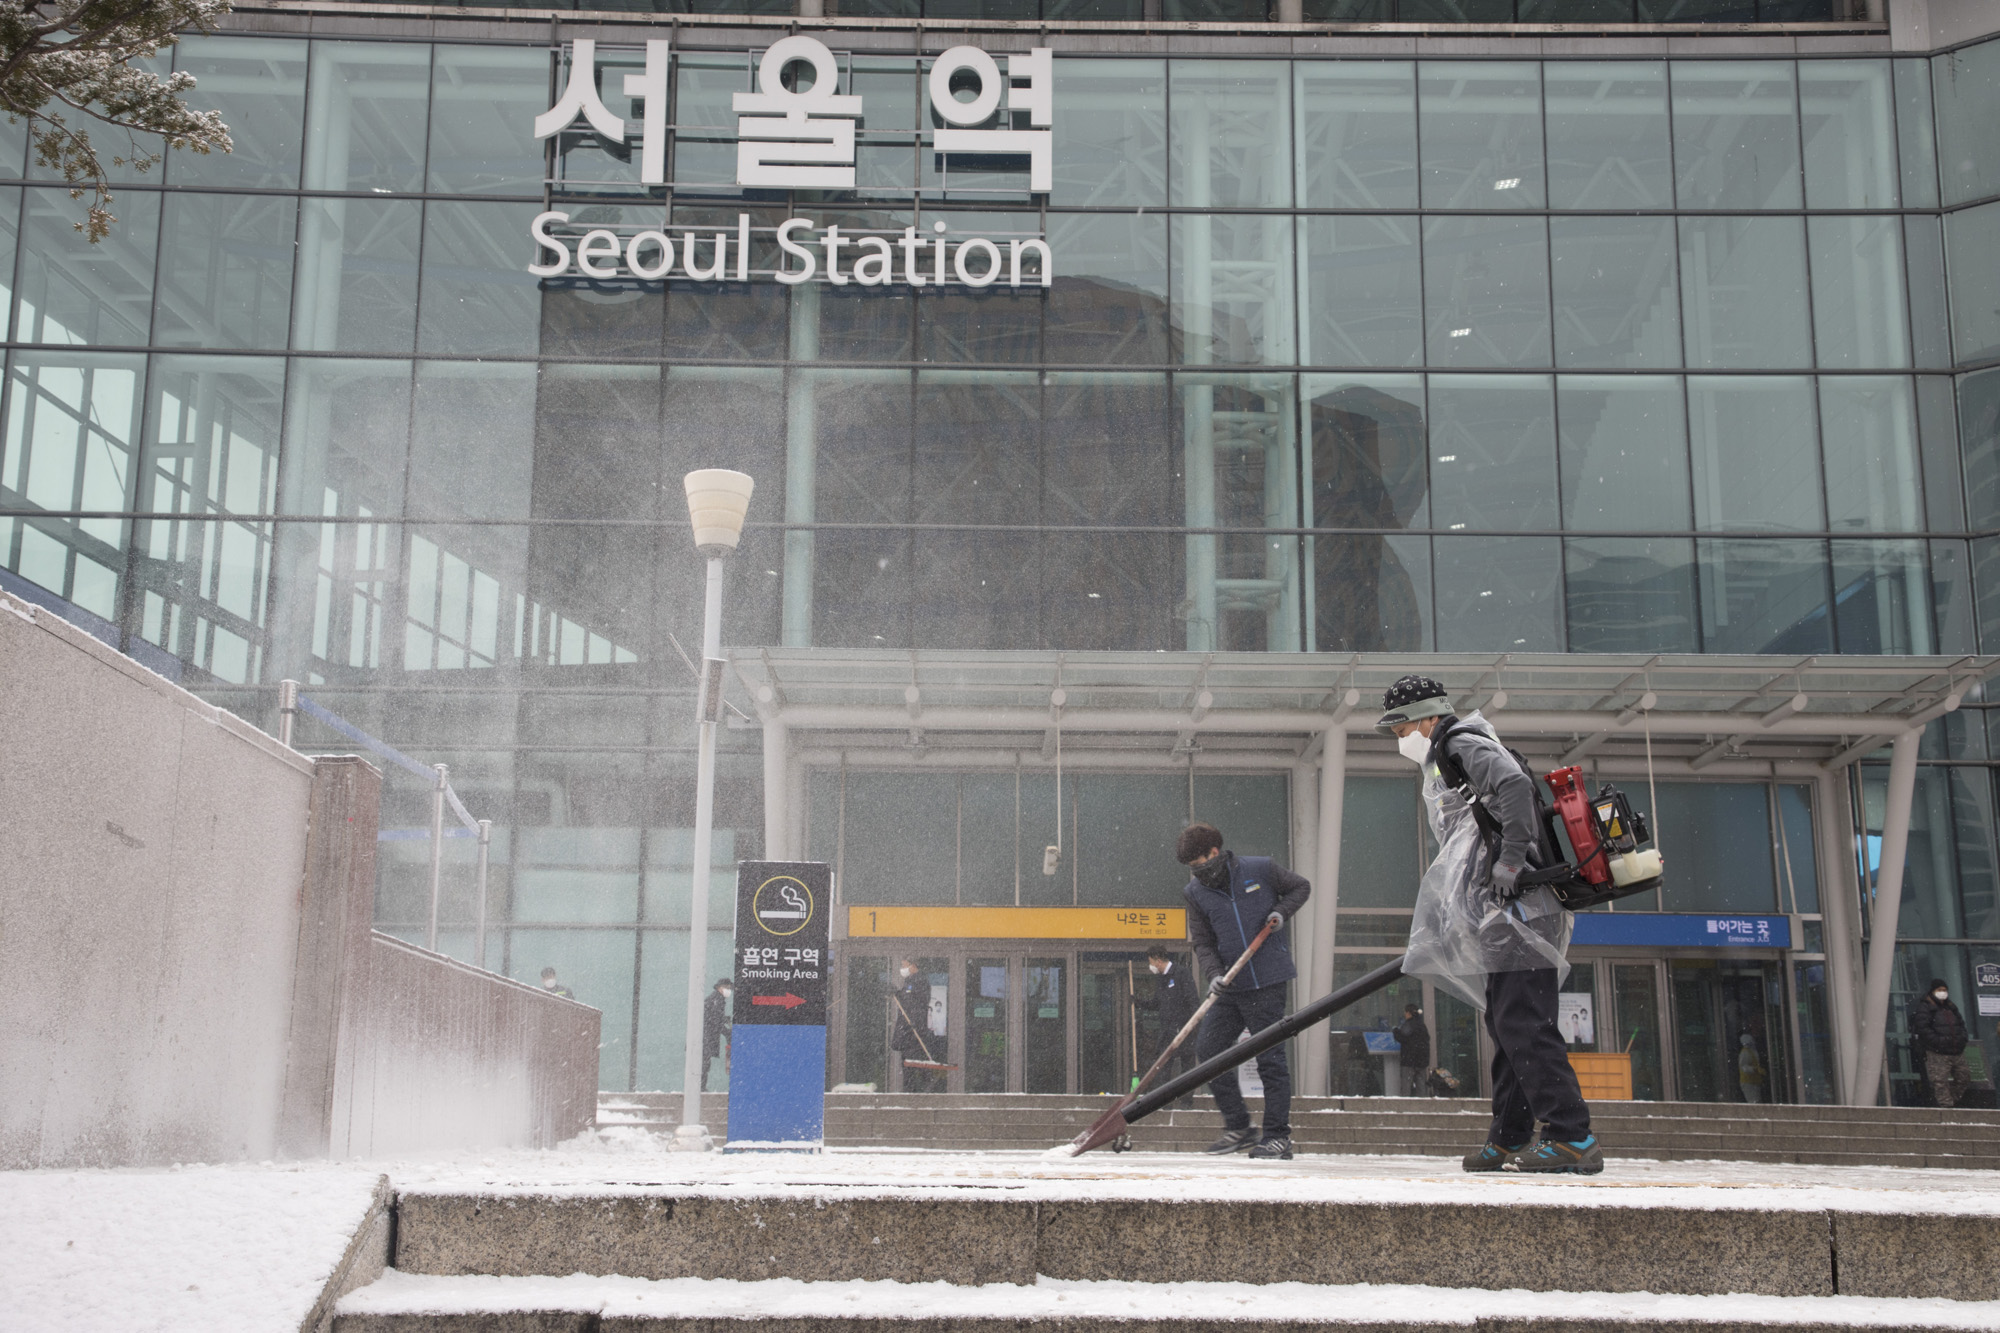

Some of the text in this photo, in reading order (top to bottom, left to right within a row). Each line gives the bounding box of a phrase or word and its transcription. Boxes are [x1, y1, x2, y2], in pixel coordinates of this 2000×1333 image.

[534, 35, 1053, 193] 서울역
[528, 211, 1052, 288] Seoul Station
[869, 911, 876, 933] 1
[1117, 913, 1166, 925] 나오는 곳
[1707, 920, 1768, 934] 들어가는 곳
[744, 947, 819, 966] 흡연 구역
[742, 968, 818, 981] Smoking Area
[1982, 975, 2000, 984] 405
